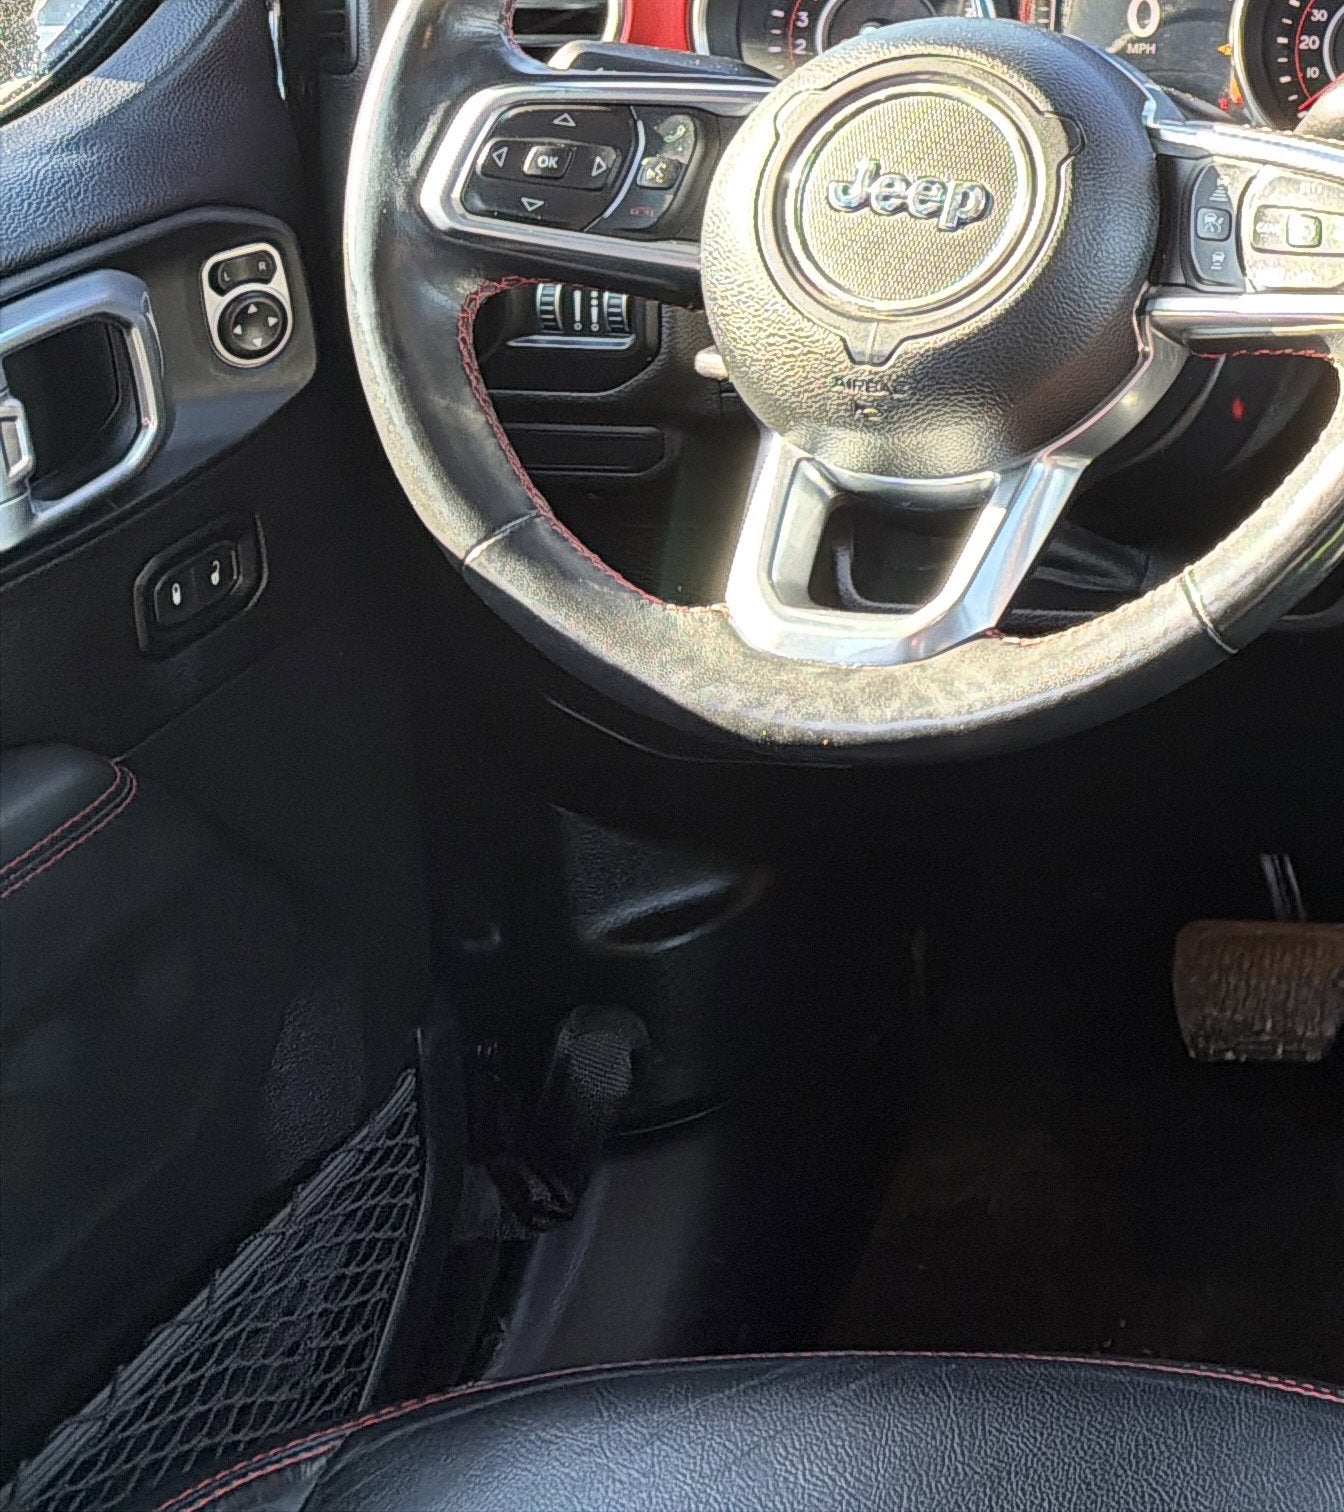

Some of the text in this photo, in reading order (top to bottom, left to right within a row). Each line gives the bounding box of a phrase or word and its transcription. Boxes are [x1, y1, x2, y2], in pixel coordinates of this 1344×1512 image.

[796, 11, 809, 28] 3
[1310, 9, 1328, 22] 30
[794, 38, 807, 55] 2
[1126, 43, 1157, 55] MPH
[1298, 35, 1320, 50] 20
[1306, 66, 1320, 78] 10
[537, 155, 559, 168] OK
[828, 157, 995, 232] Jeep
[223, 271, 231, 282] L
